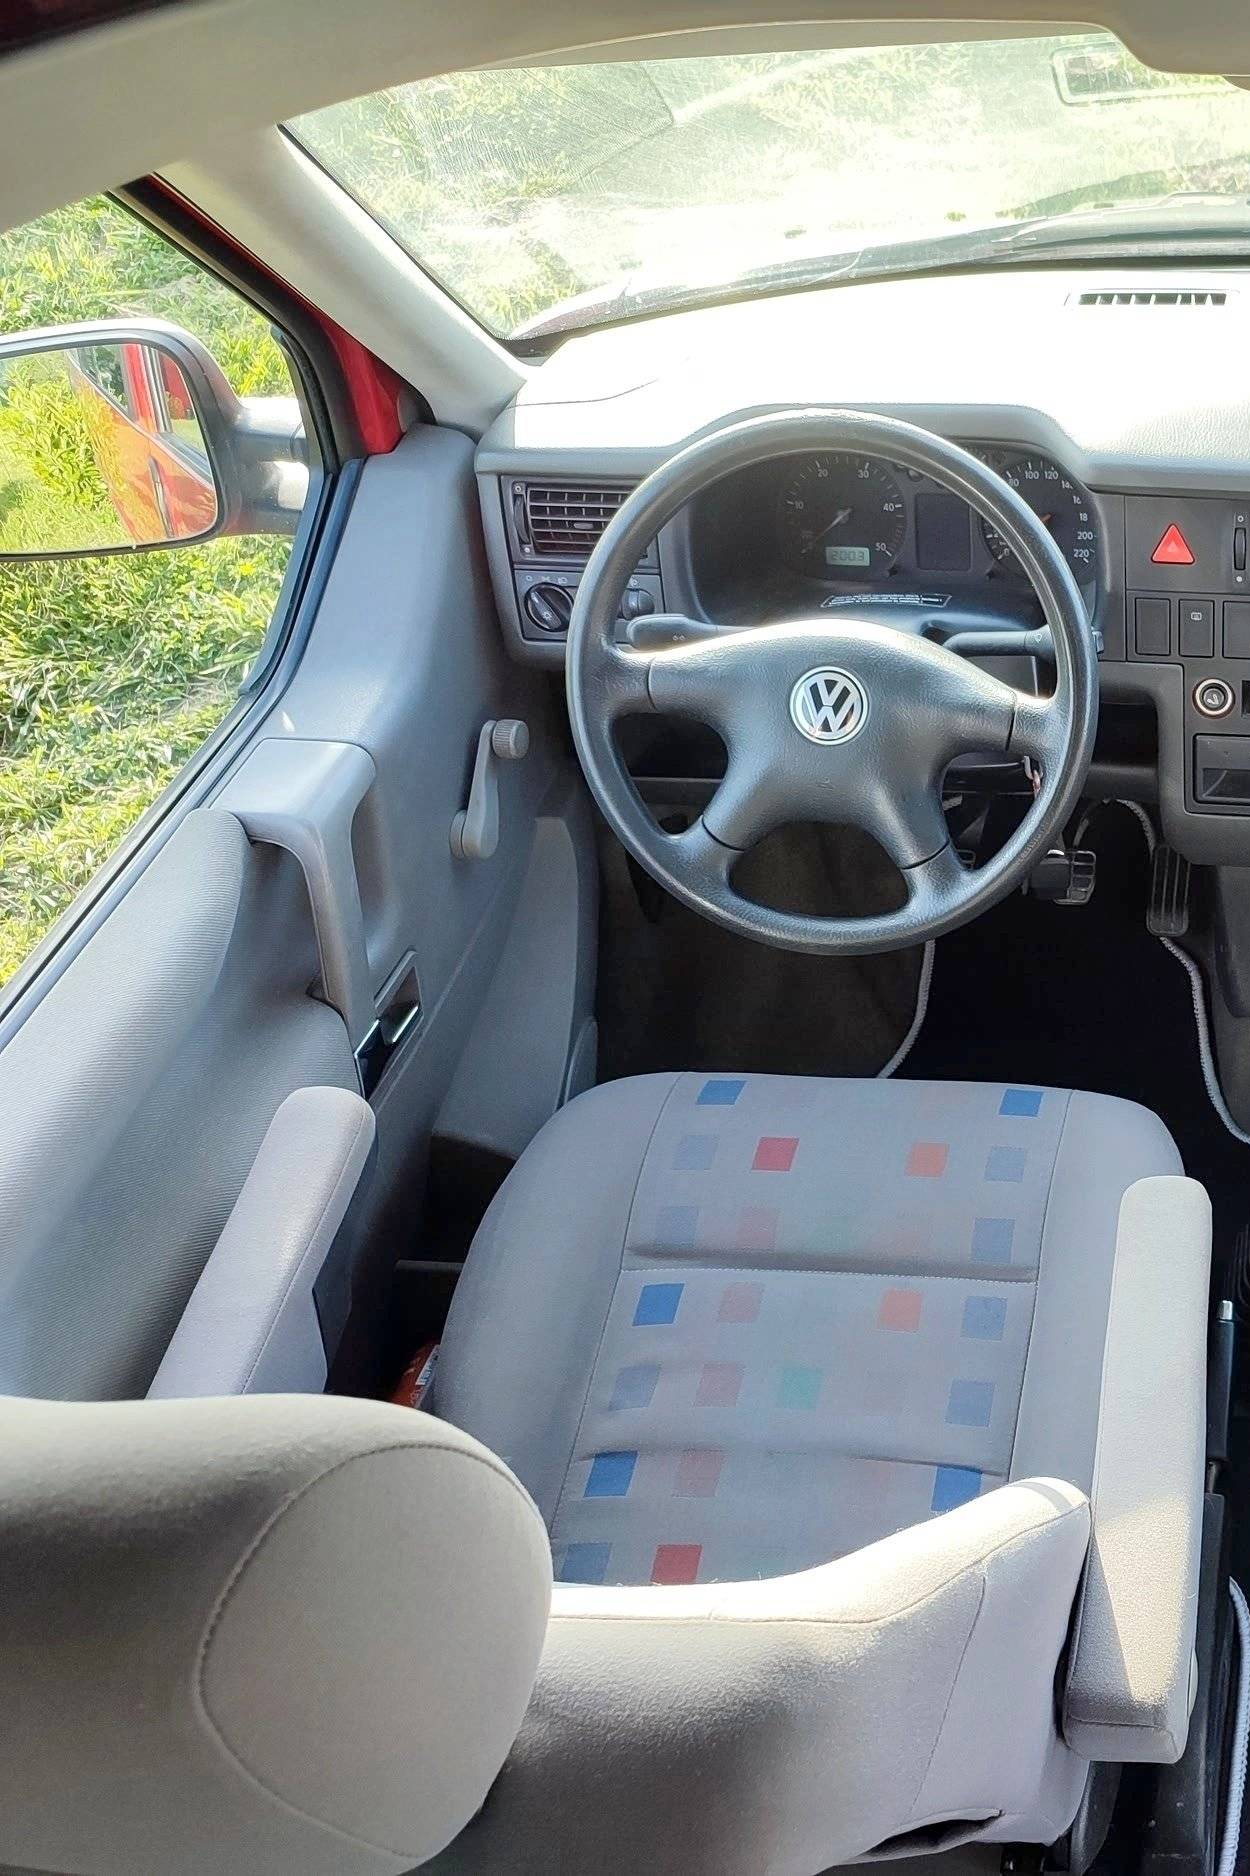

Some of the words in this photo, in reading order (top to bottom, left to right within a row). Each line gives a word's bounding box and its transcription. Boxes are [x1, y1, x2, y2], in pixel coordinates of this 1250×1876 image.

[818, 468, 828, 478] 20
[858, 469, 869, 479] 30
[1025, 471, 1039, 479] 100
[1045, 471, 1058, 479] 120
[795, 501, 804, 510] 10
[883, 503, 895, 511] 40
[1077, 532, 1093, 540] 200
[876, 542, 887, 551] 50
[1073, 549, 1089, 558] 220
[798, 674, 860, 738] VW
